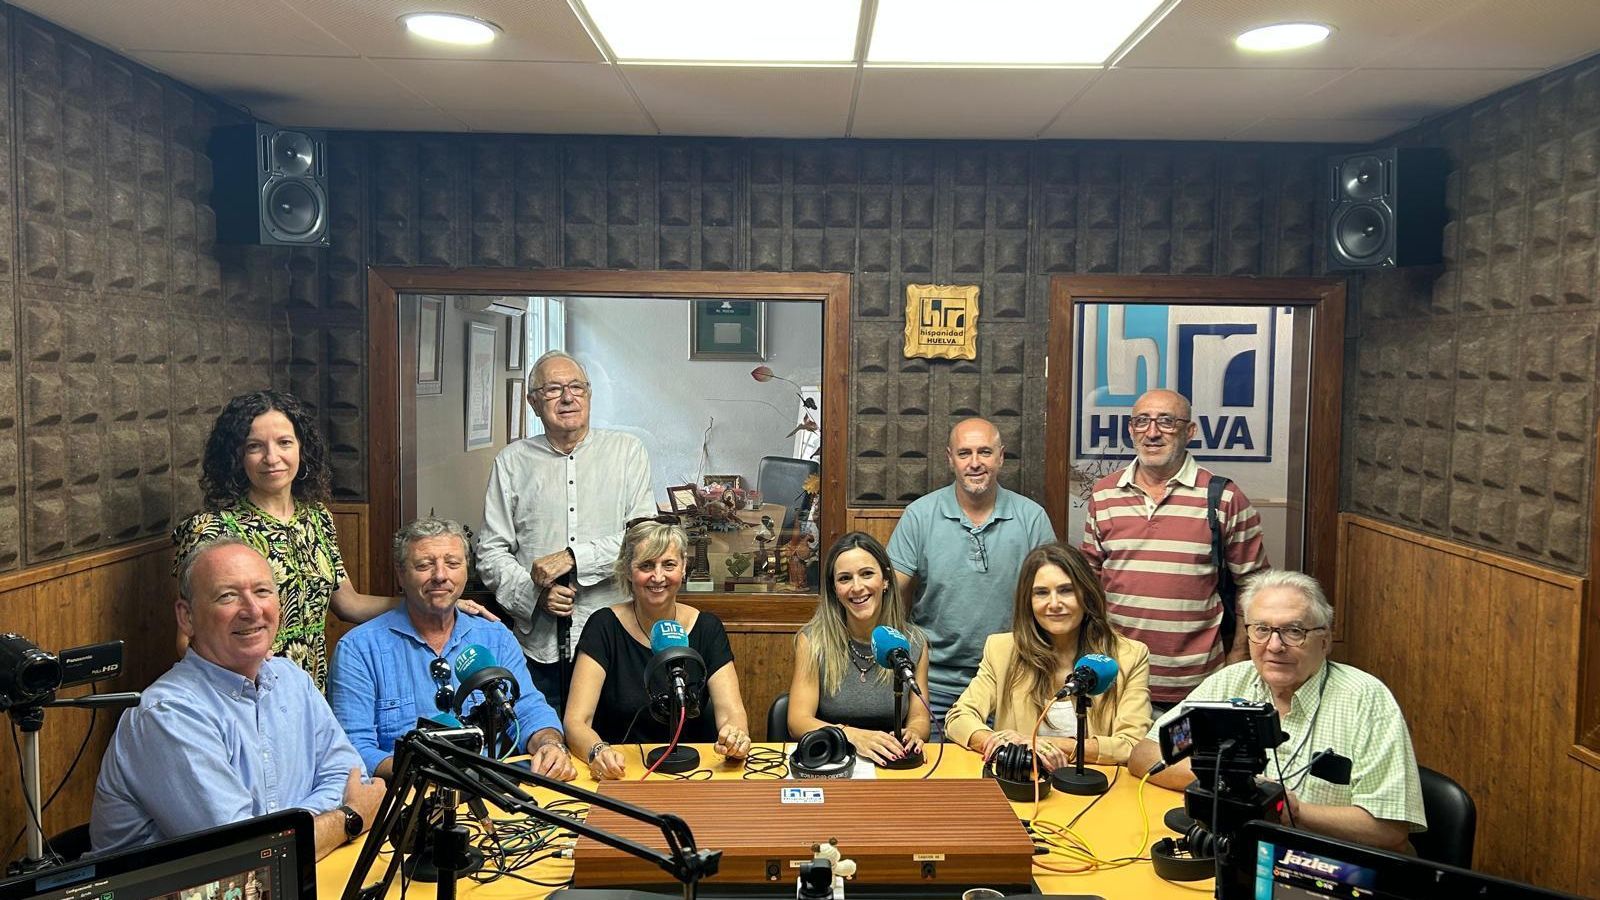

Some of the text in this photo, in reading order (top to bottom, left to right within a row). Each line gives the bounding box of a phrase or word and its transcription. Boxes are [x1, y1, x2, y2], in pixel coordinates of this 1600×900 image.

[920, 329, 964, 337] hispanidad
[1090, 415, 1254, 449] HVA
[66, 655, 92, 663] Panasonic
[102, 664, 118, 672] HD
